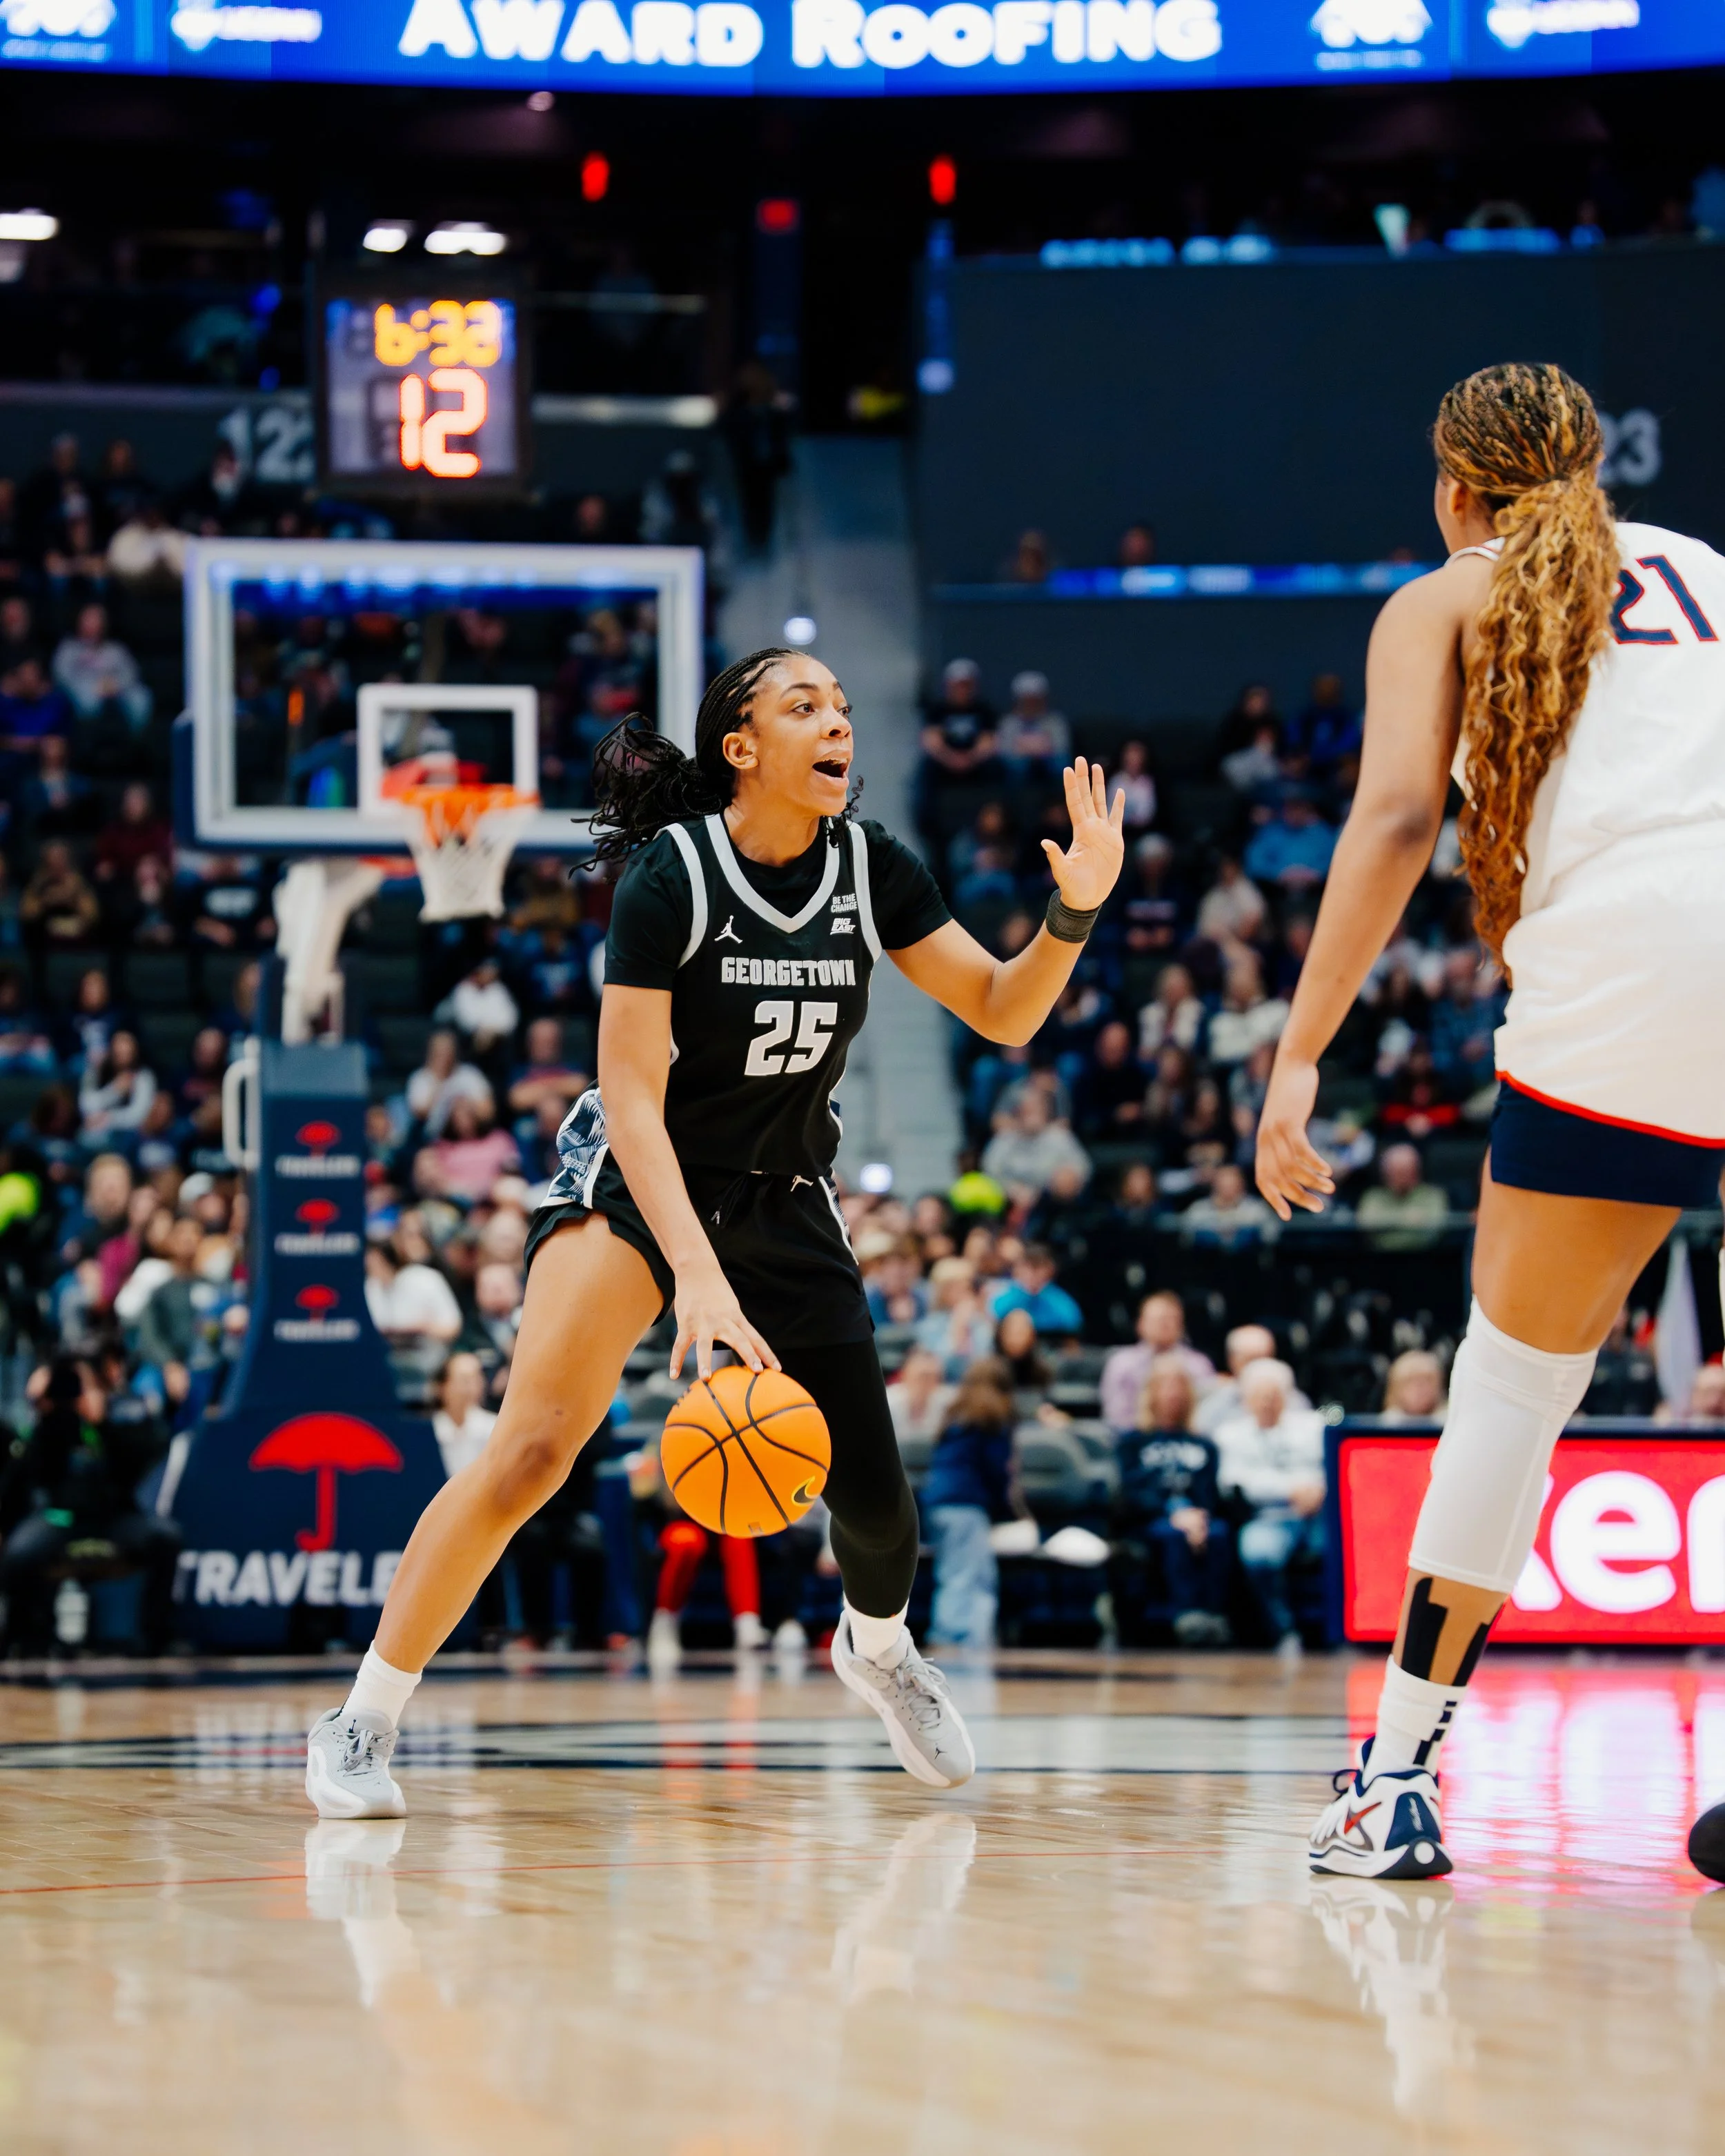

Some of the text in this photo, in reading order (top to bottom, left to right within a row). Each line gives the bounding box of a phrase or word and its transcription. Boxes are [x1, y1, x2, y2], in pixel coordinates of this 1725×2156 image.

[398, 0, 764, 66] AWARD
[792, 0, 1223, 69] ROOFING
[400, 368, 487, 477] 12
[1609, 555, 1719, 644] 21
[831, 902, 858, 913] CHANGE
[833, 893, 856, 904] BE THE
[722, 957, 856, 986] GEORGETOWN
[745, 1000, 838, 1076] 25
